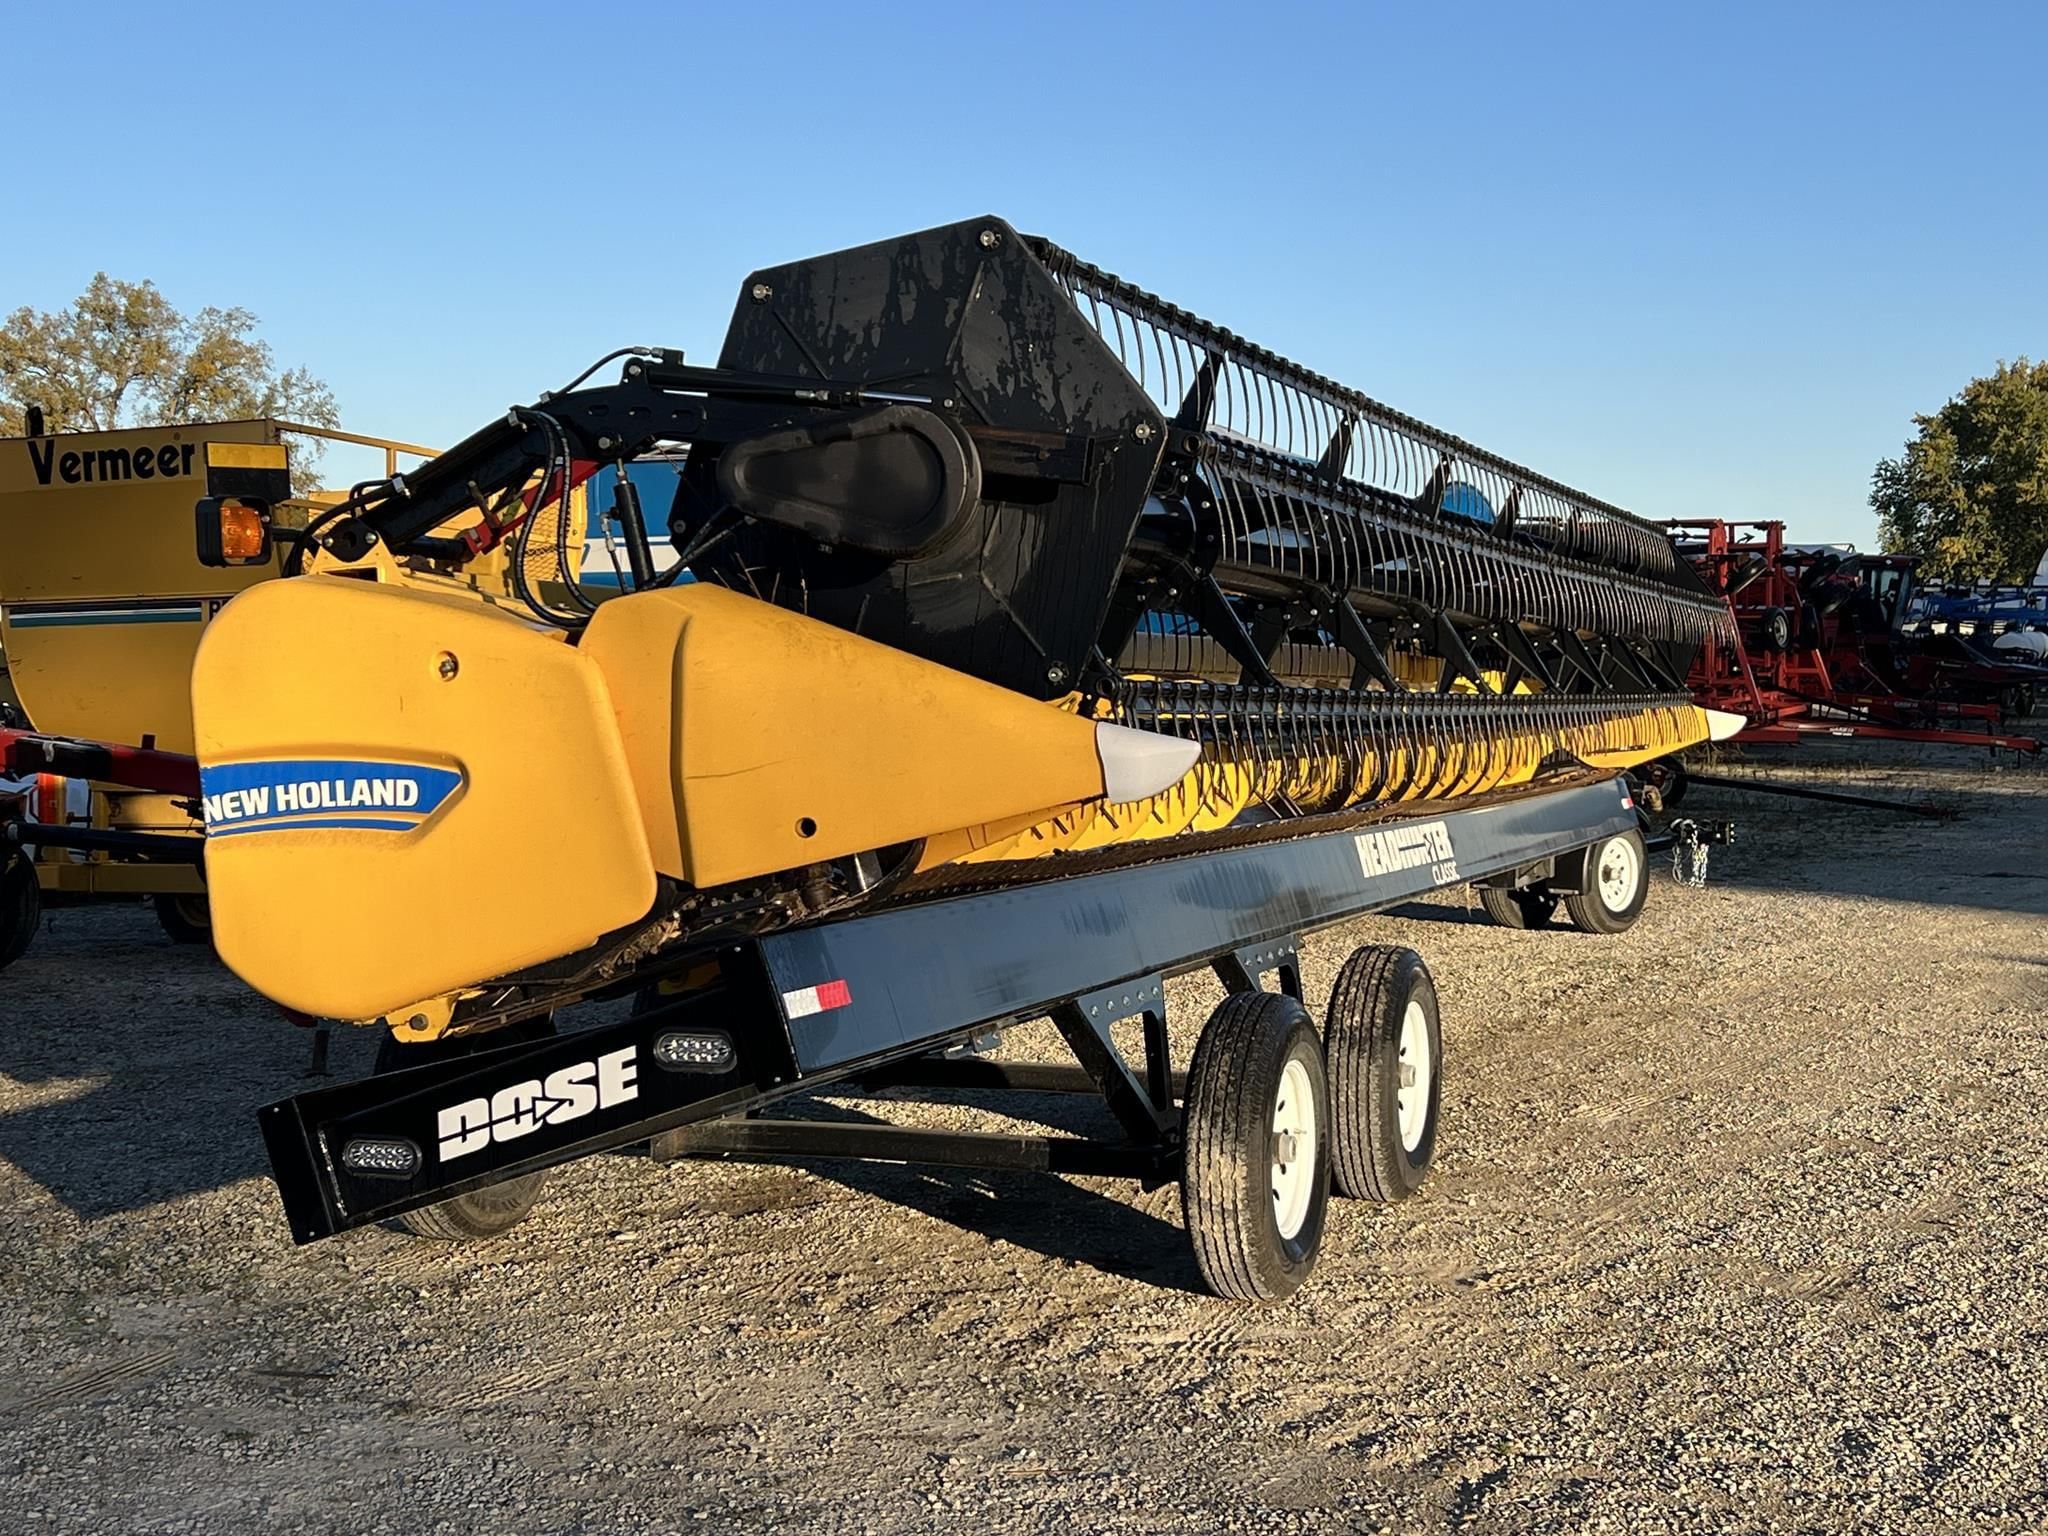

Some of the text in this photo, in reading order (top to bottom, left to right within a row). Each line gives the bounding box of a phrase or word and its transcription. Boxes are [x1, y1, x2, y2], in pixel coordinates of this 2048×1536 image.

[27, 439, 195, 485] Vermeer
[203, 778, 419, 824] NEW HOLLAND
[1432, 860, 1461, 886] CLASSIC
[437, 1045, 639, 1163] DOSE
